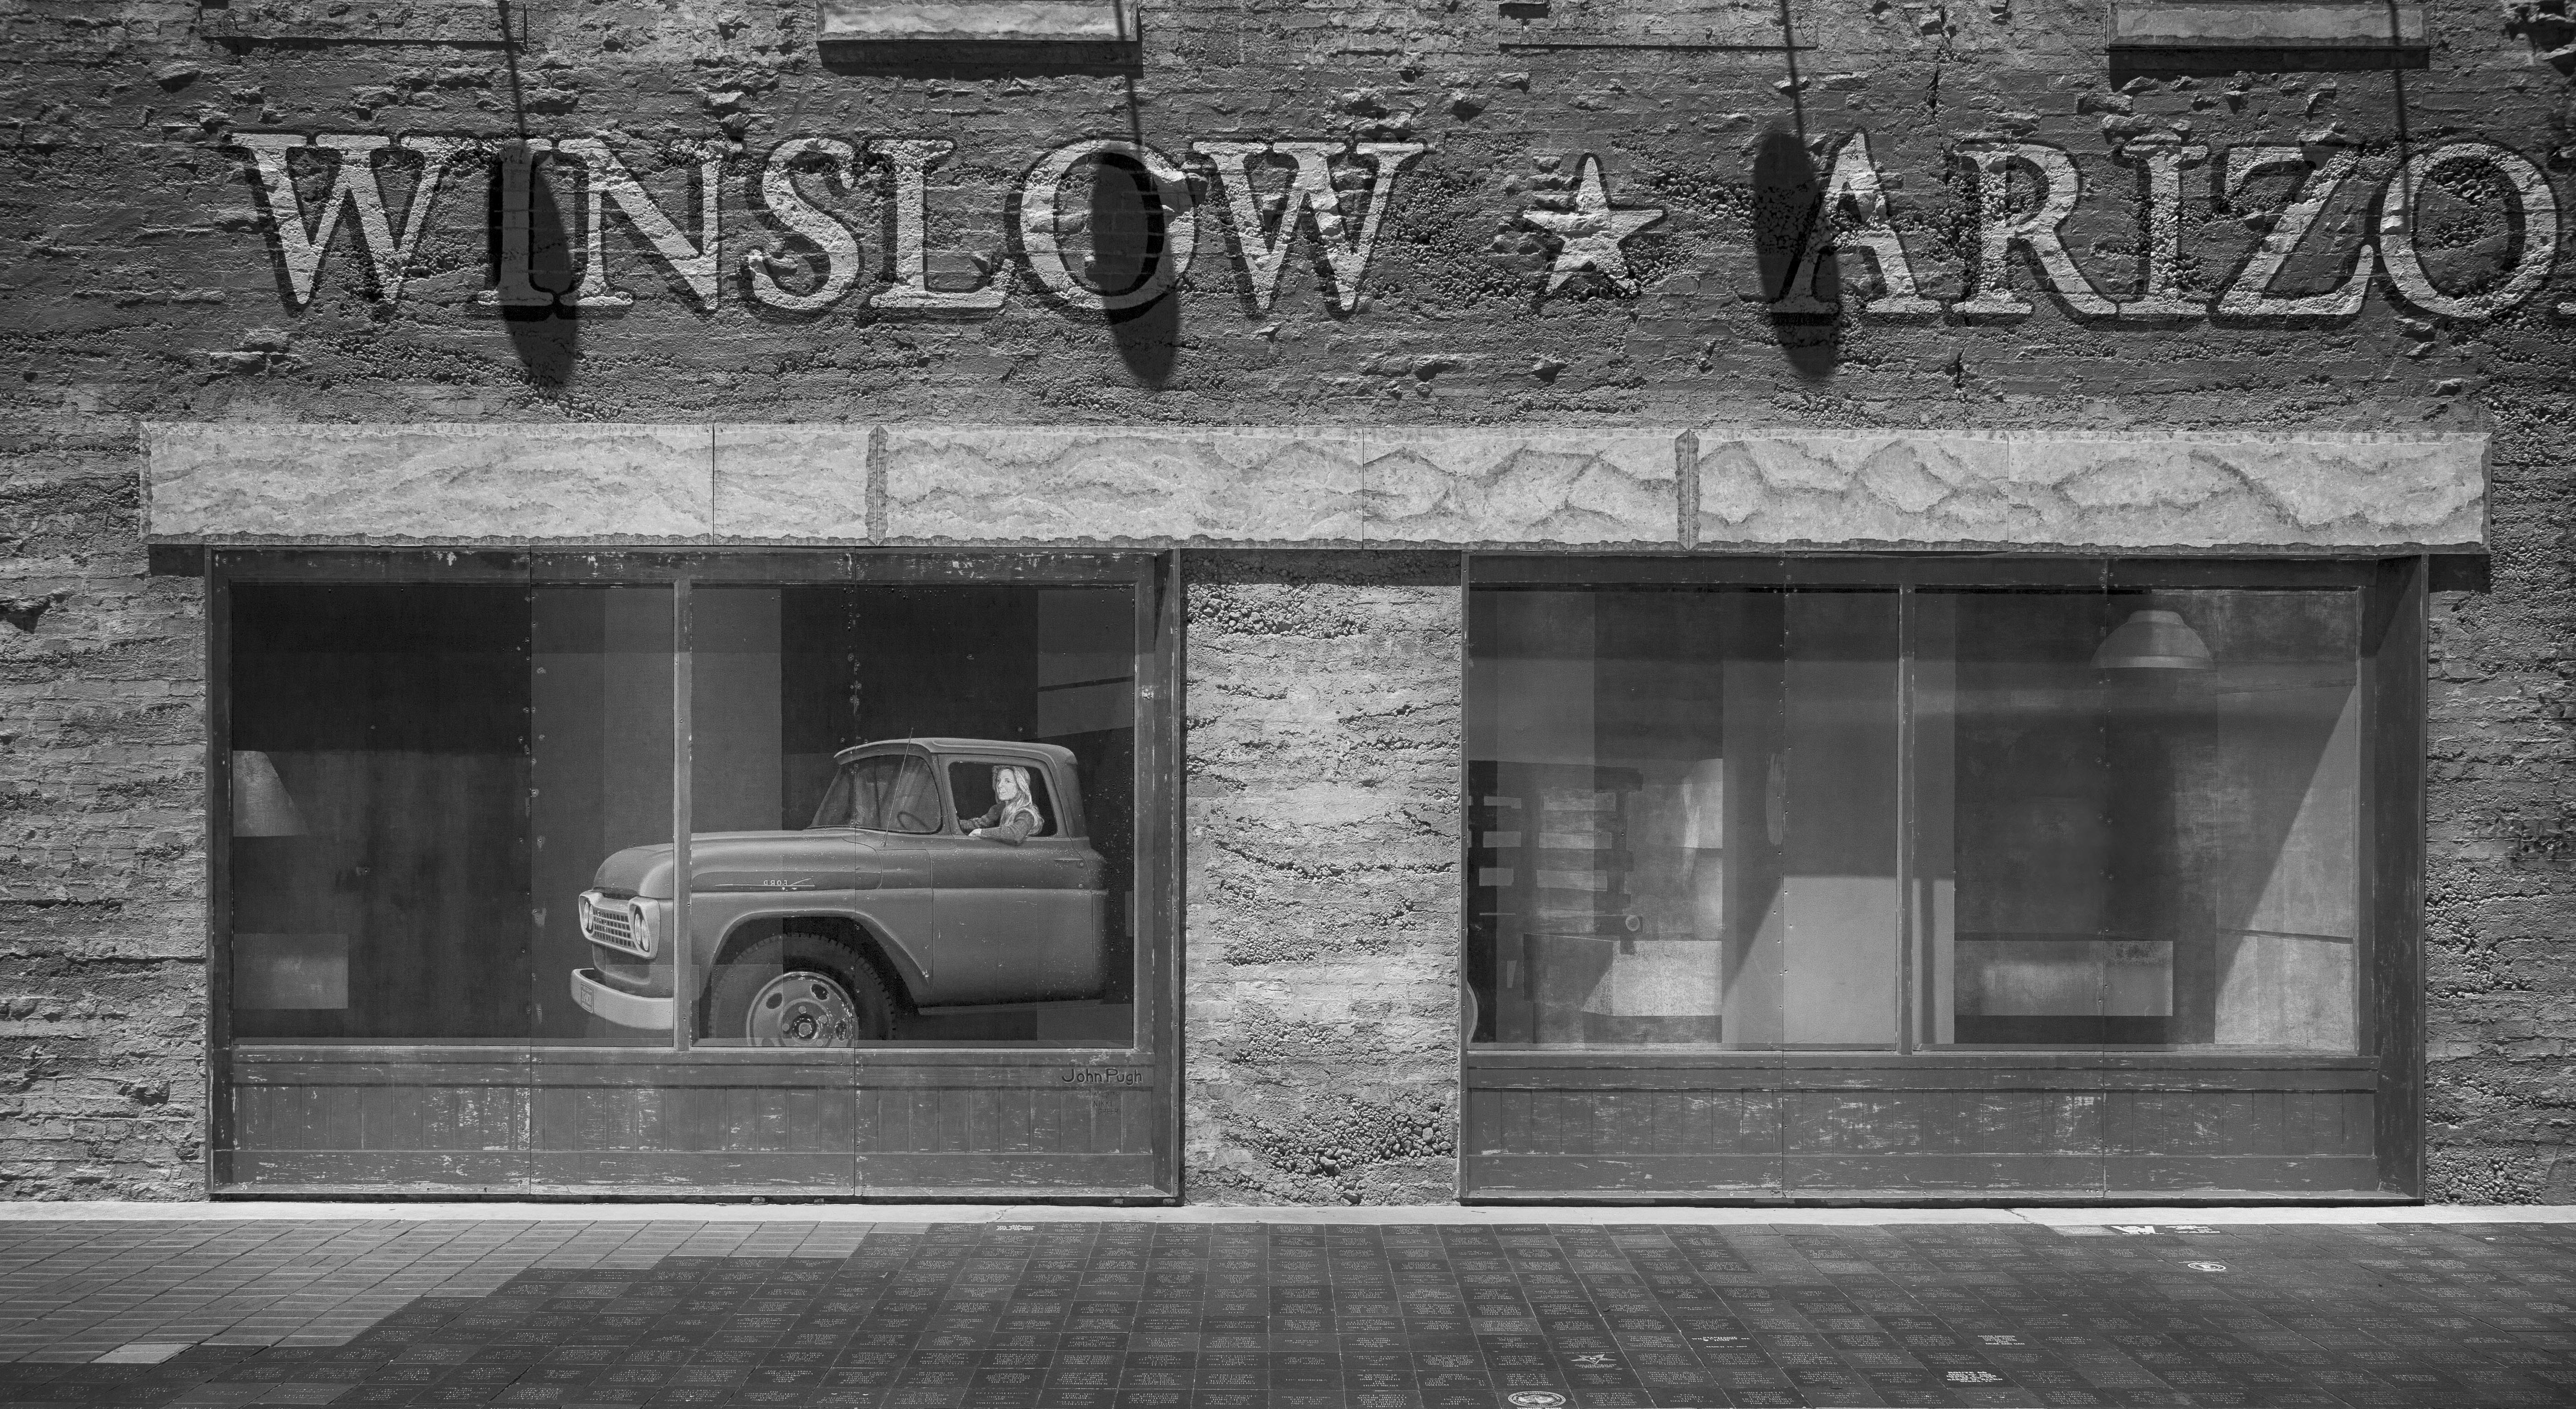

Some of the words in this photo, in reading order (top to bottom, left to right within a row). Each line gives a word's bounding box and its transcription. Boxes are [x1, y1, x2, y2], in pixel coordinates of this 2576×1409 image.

[226, 132, 1427, 317] WINSLOW
[1771, 127, 2576, 322] ARIZO
[1062, 1068, 1104, 1083] John
[1105, 1068, 1143, 1086] Pugh
